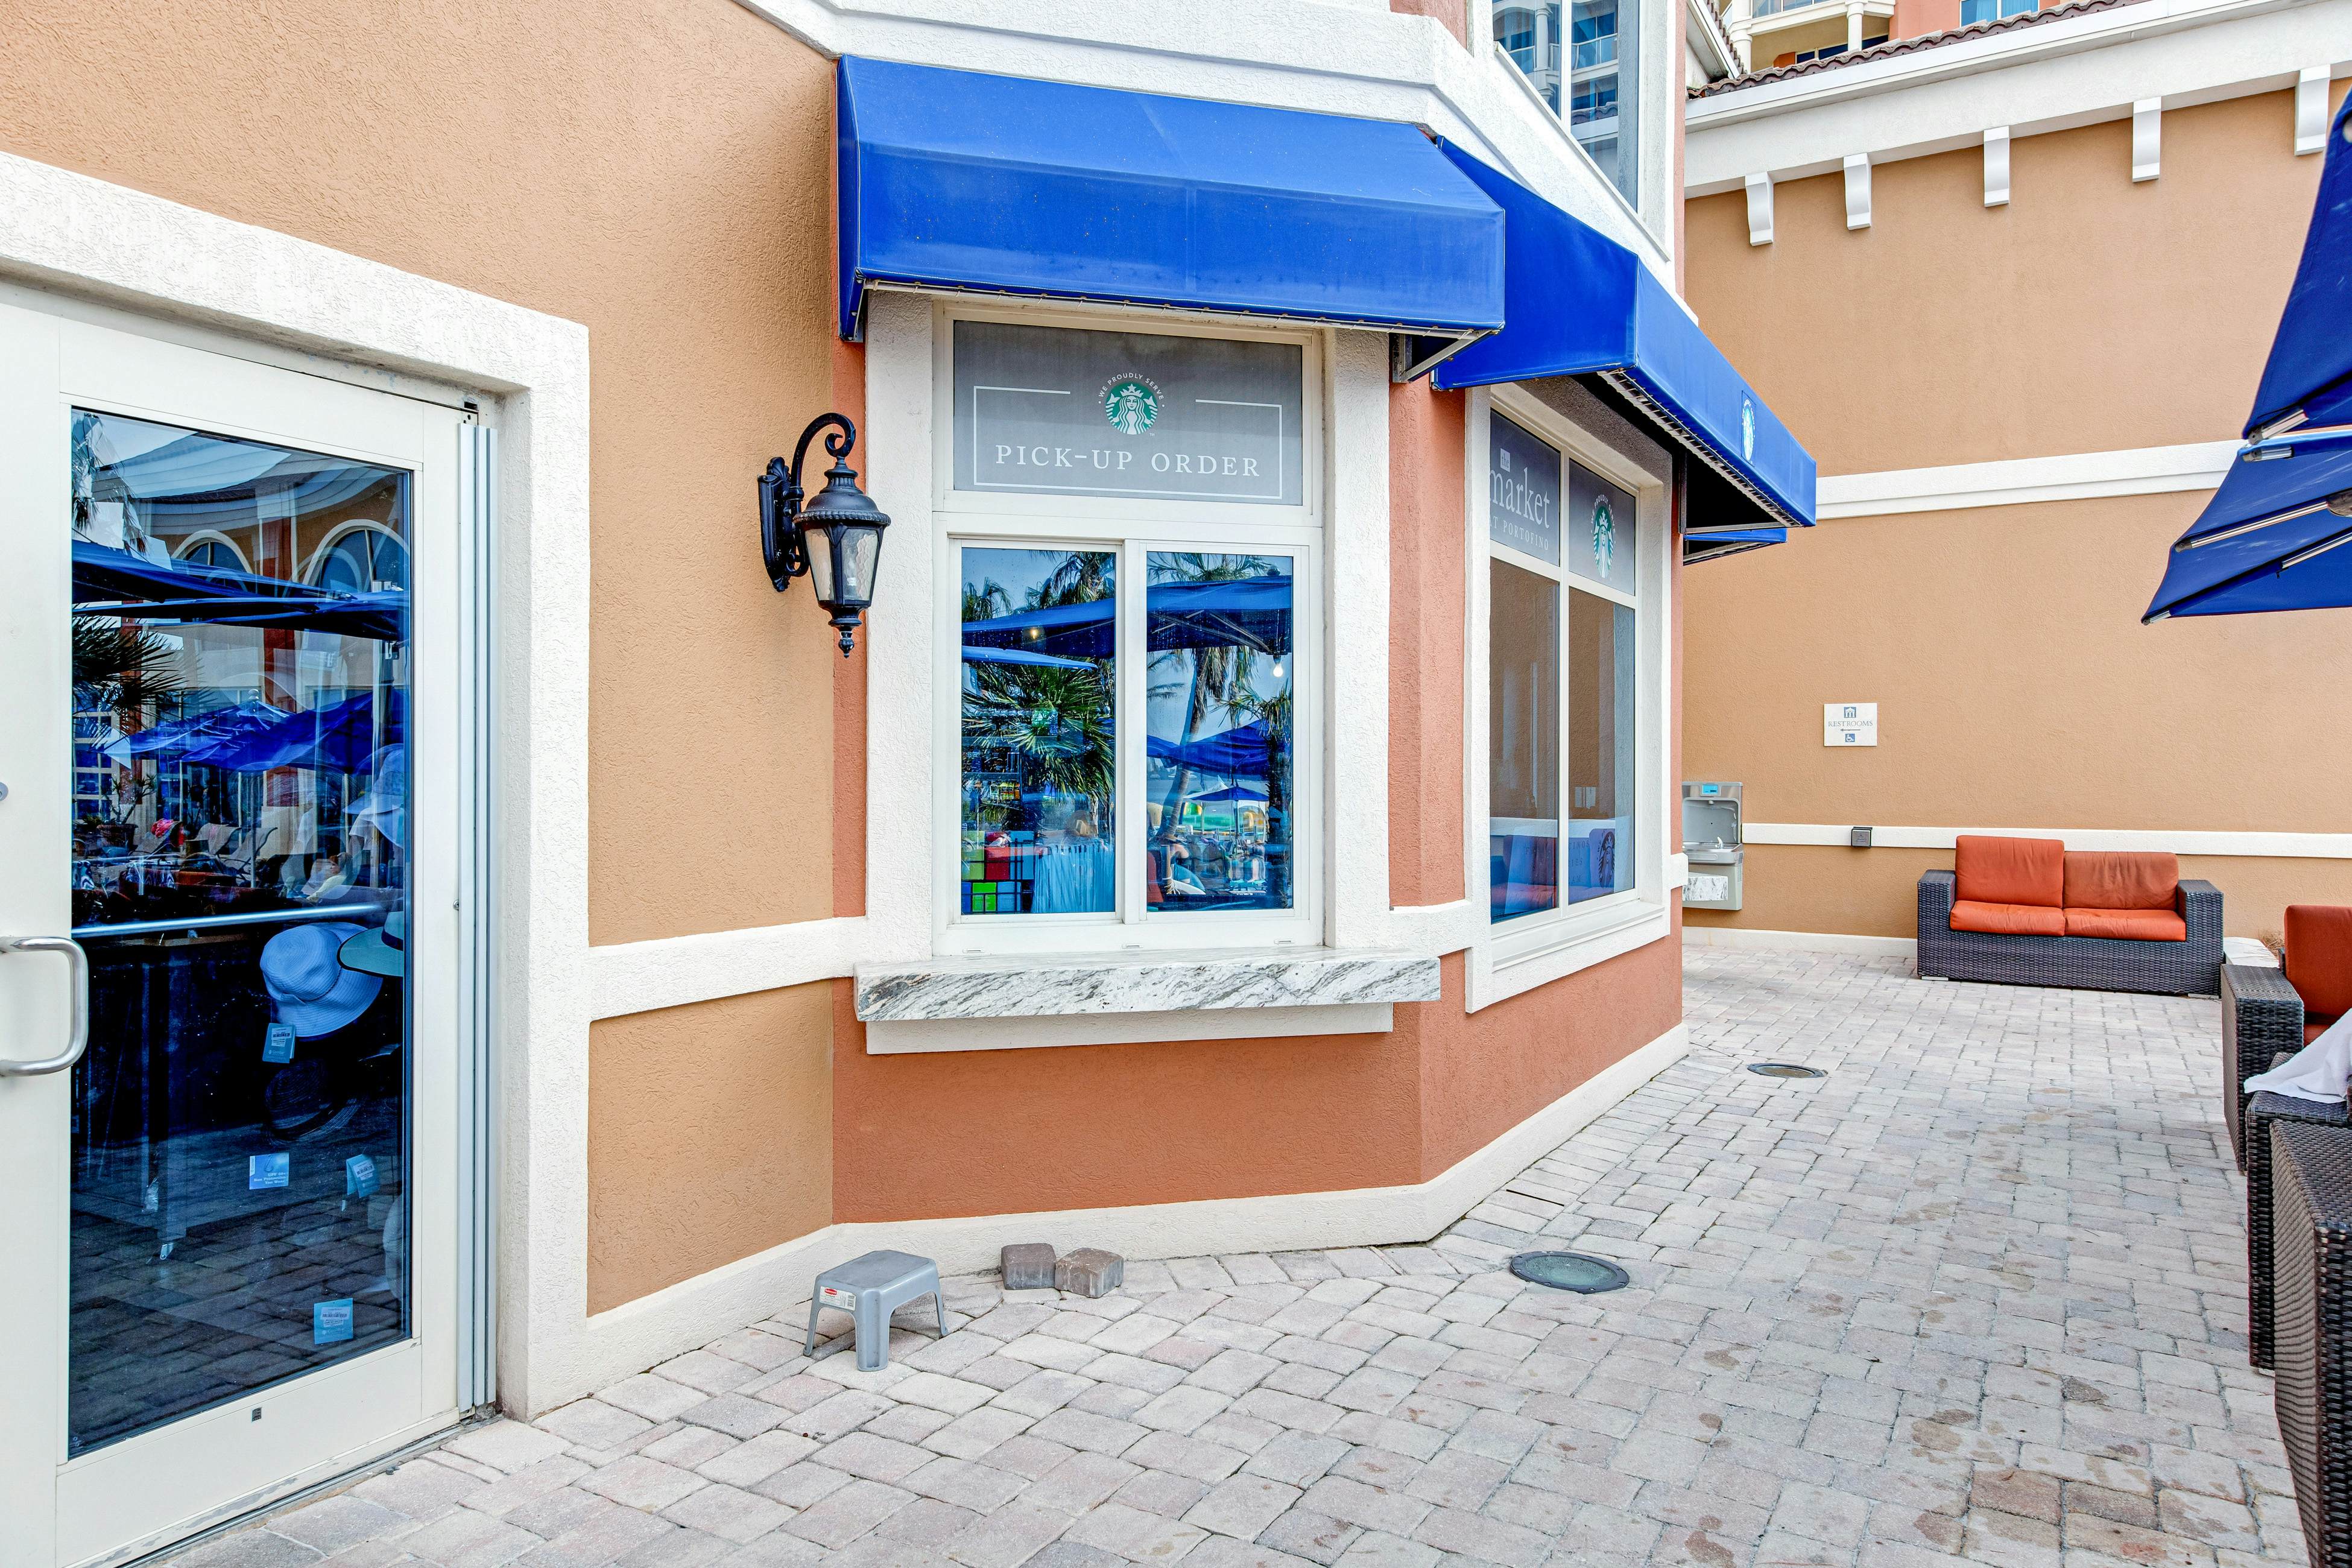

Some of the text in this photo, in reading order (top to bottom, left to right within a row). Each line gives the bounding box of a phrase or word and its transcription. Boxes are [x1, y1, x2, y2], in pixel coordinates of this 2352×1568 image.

[1098, 372, 1164, 400] WE PROUDLY SERVE
[995, 444, 1260, 477] PICK-UP ORDER
[1501, 453, 1510, 468] the
[1490, 467, 1550, 529] market
[1503, 520, 1549, 551] PORTOFINO
